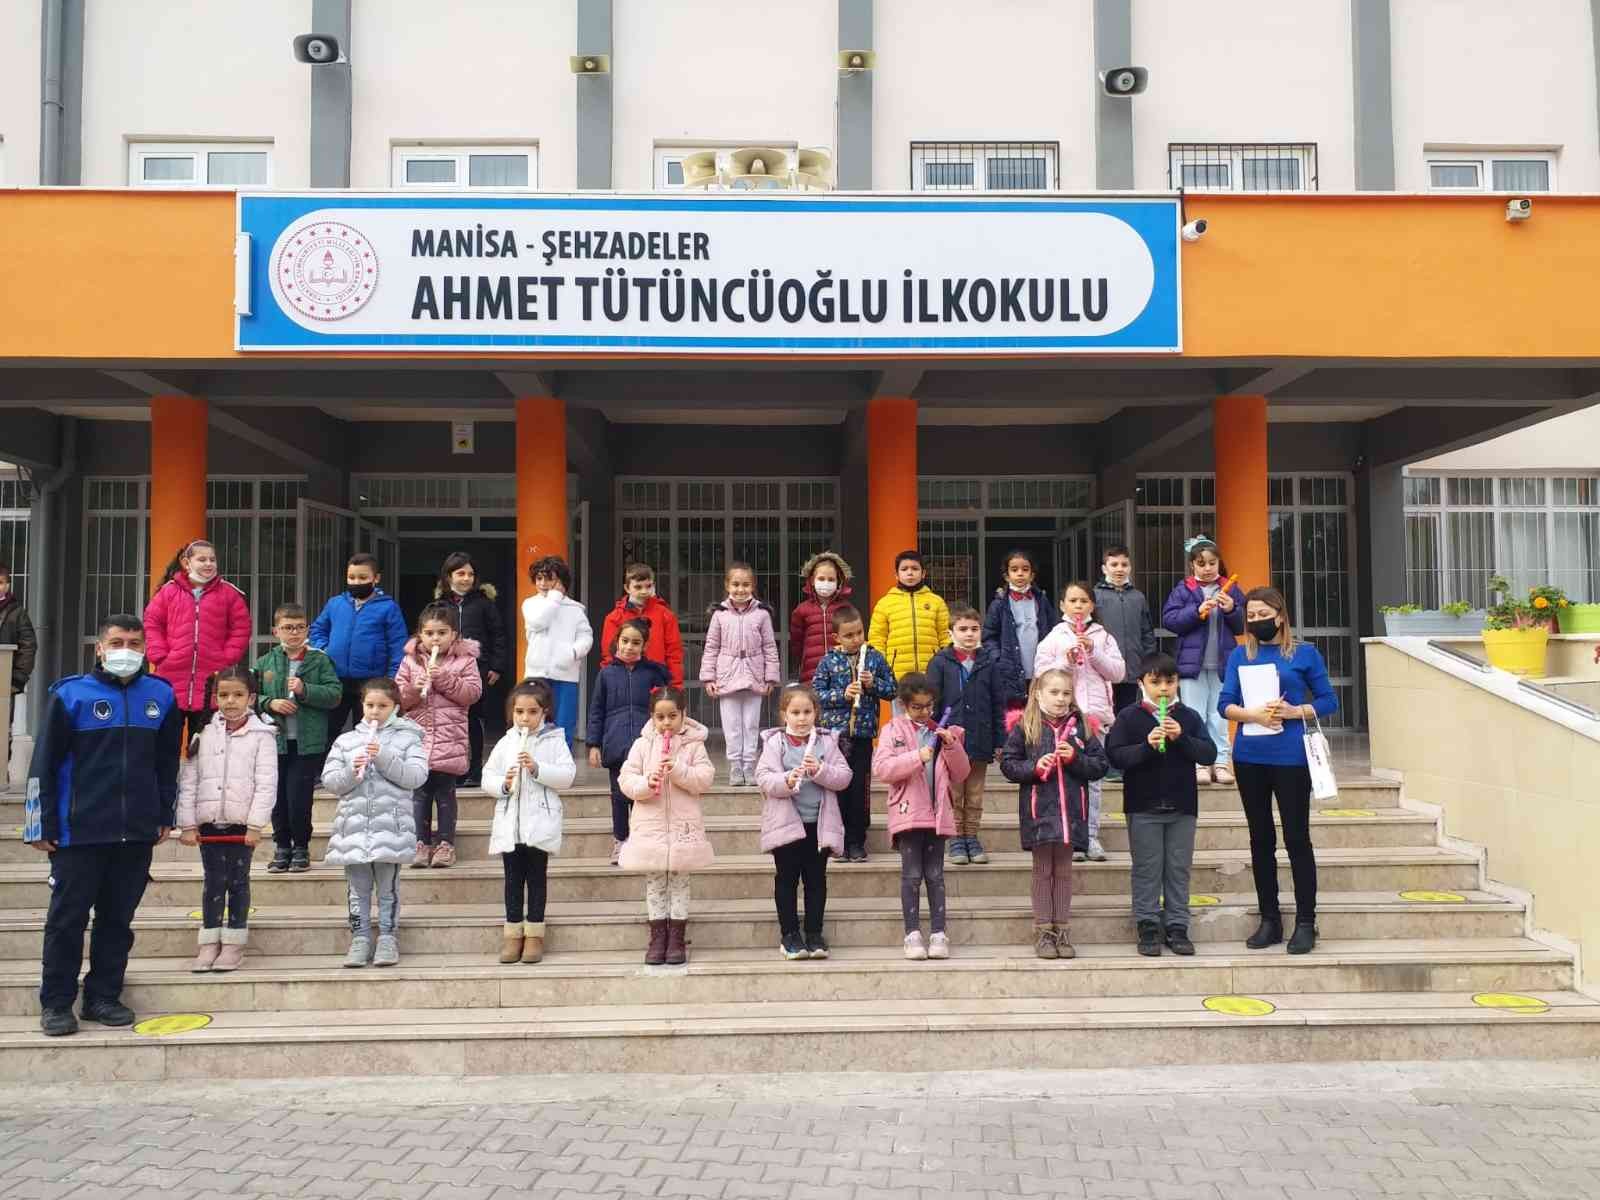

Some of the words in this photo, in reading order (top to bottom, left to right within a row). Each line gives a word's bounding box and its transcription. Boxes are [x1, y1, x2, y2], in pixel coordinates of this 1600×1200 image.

[411, 223, 518, 258] MANİSA
[542, 230, 710, 265] ŞEHZADELER
[411, 275, 565, 321] AHMET
[574, 267, 888, 324] TÜTÜNCÜOĞLU
[903, 269, 1108, 323] İLKOKULU
